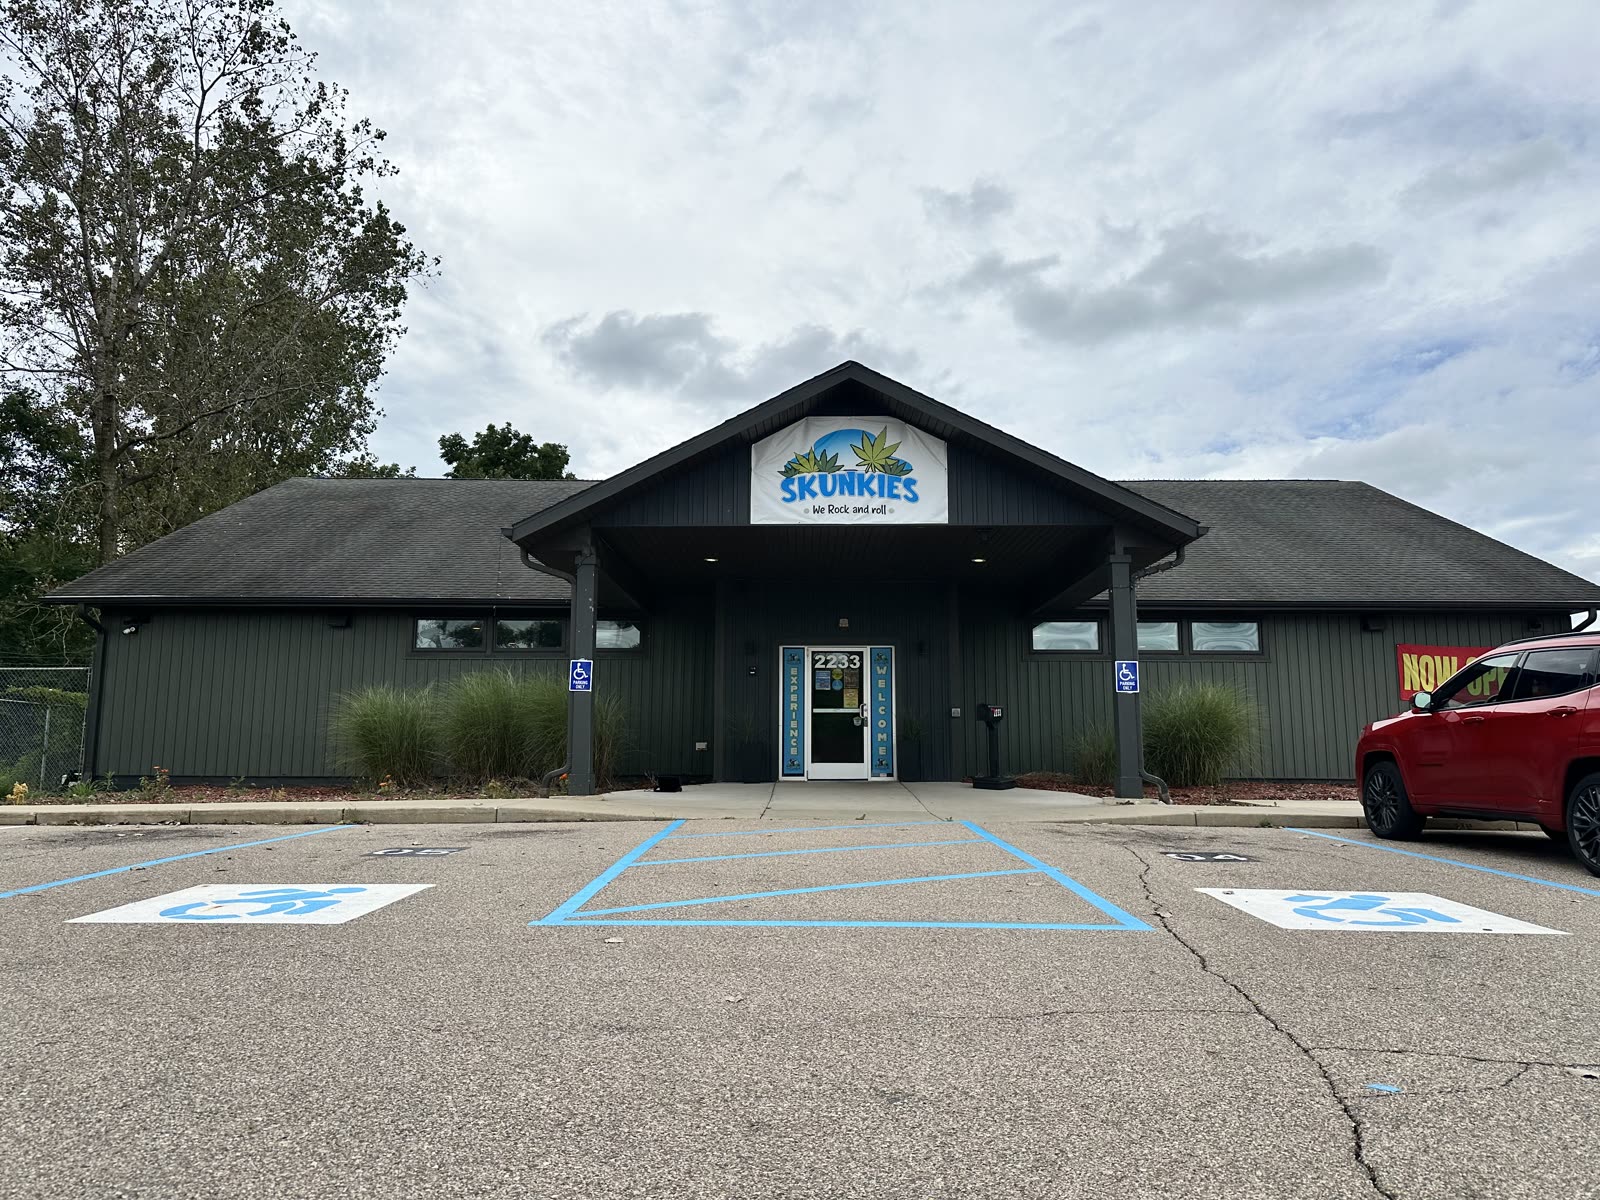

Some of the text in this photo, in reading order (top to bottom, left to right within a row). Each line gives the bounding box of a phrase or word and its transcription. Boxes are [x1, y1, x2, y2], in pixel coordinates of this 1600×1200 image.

[781, 472, 919, 503] SKUNKIES
[812, 504, 887, 515] We Rock and roll
[814, 655, 861, 669] 2233
[1402, 653, 1458, 692] NOW
[790, 667, 799, 755] EXPERIENCE
[877, 666, 888, 755] WELCOME
